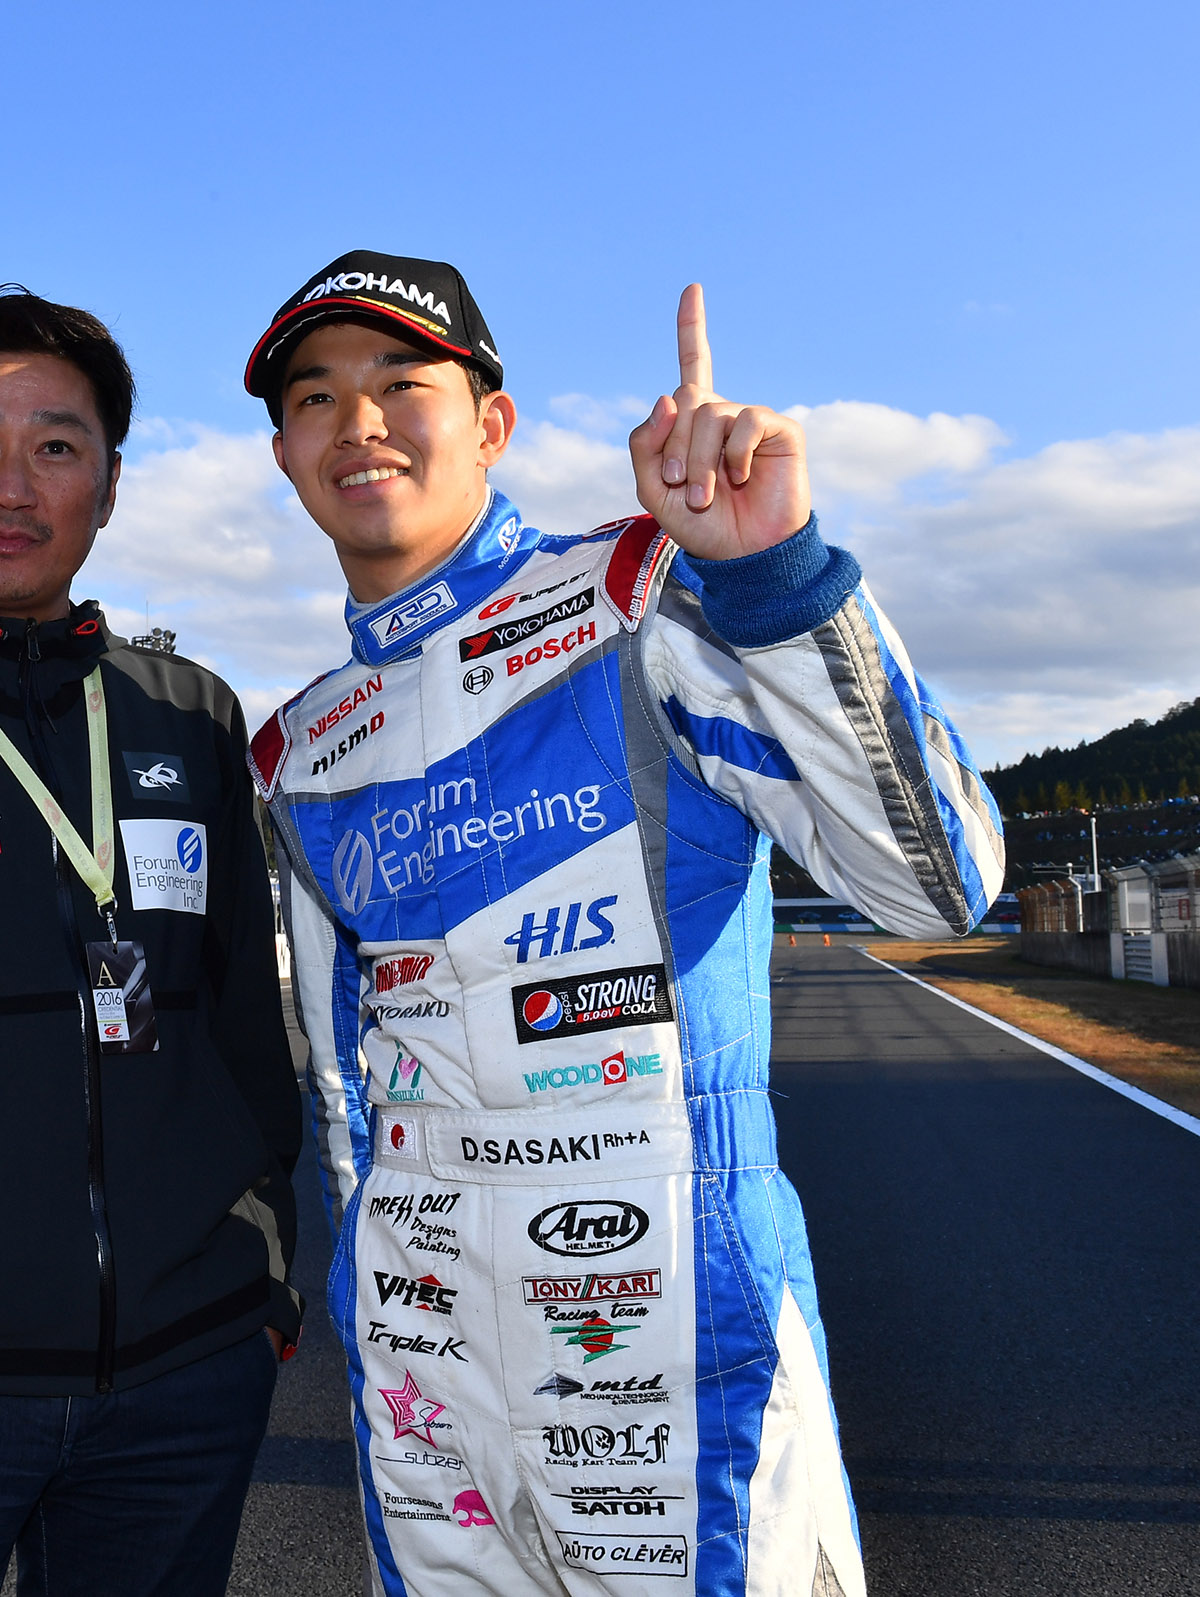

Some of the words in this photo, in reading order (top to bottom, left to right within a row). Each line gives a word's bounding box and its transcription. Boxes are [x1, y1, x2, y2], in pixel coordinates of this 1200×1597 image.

[297, 272, 451, 325] OKOHAMA
[519, 580, 568, 603] SUPER
[385, 592, 442, 636] ARD
[494, 595, 589, 645] YOKOHAMA
[506, 621, 596, 676] BOSCH
[307, 674, 383, 745] NISSAN
[311, 711, 385, 776] nismo
[371, 776, 477, 853] Forum
[377, 784, 608, 895] Engineering
[133, 855, 179, 871] Forum
[136, 872, 203, 897] Engineering
[96, 960, 117, 987] A
[96, 992, 123, 1006] 2016
[558, 990, 575, 1023] pepsi
[574, 974, 657, 1012] STRONG
[622, 1001, 657, 1015] COLA
[523, 1052, 664, 1094] WOODONE
[461, 1133, 601, 1165] D.SASAKI
[418, 1192, 462, 1216] OUT
[537, 1205, 637, 1242] Arai
[405, 1236, 461, 1262] Painting
[526, 1278, 581, 1299] TONY
[597, 1271, 659, 1296] KART
[544, 1305, 601, 1322] Racing
[590, 1373, 664, 1392] mtd
[544, 1457, 578, 1468] Racing
[582, 1457, 604, 1466] Kart
[606, 1457, 637, 1466] Team
[384, 1492, 444, 1511] Fourseasons
[571, 1486, 658, 1495] DISPLAY
[571, 1501, 666, 1516] SATOH
